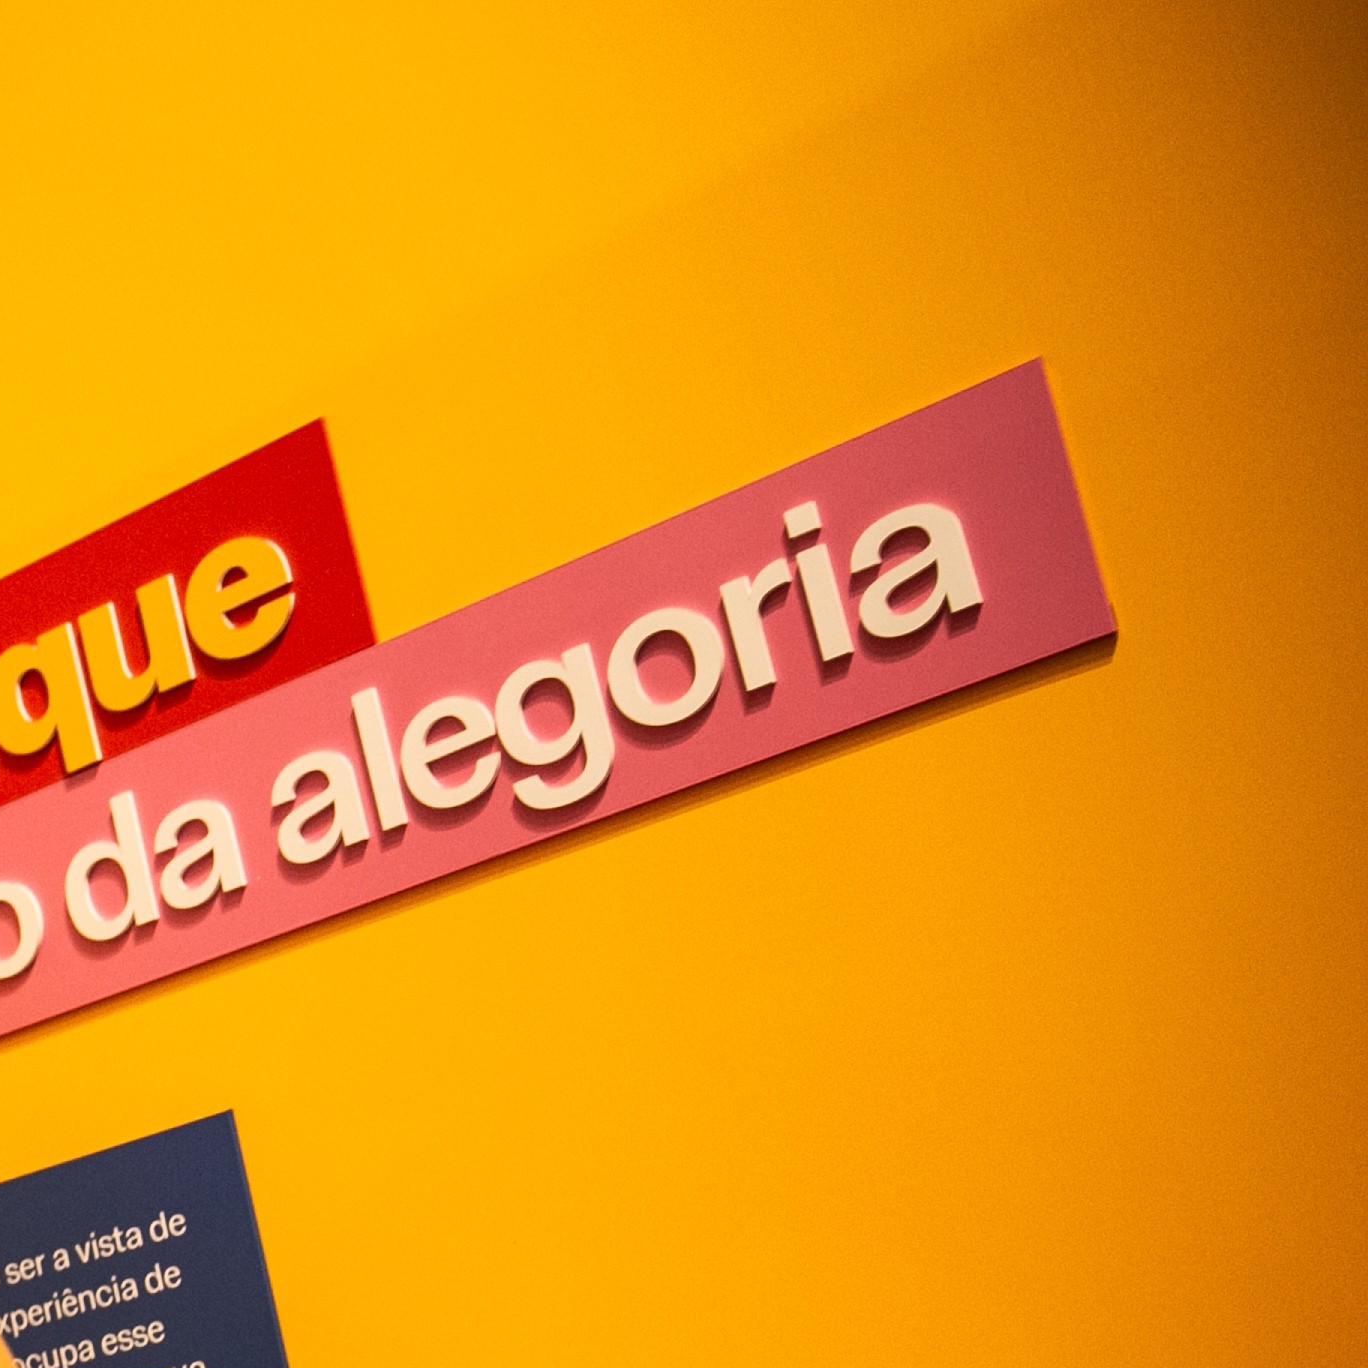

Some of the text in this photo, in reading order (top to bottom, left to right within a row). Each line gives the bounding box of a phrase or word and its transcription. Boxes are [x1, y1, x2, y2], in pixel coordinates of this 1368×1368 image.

[65, 791, 247, 942] da
[271, 500, 984, 865] alegoria
[5, 1253, 46, 1284] ser
[52, 1248, 70, 1271] a
[75, 1226, 144, 1264] vista
[149, 1211, 187, 1242] de
[145, 1263, 182, 1294] de
[101, 1320, 166, 1355] esse
